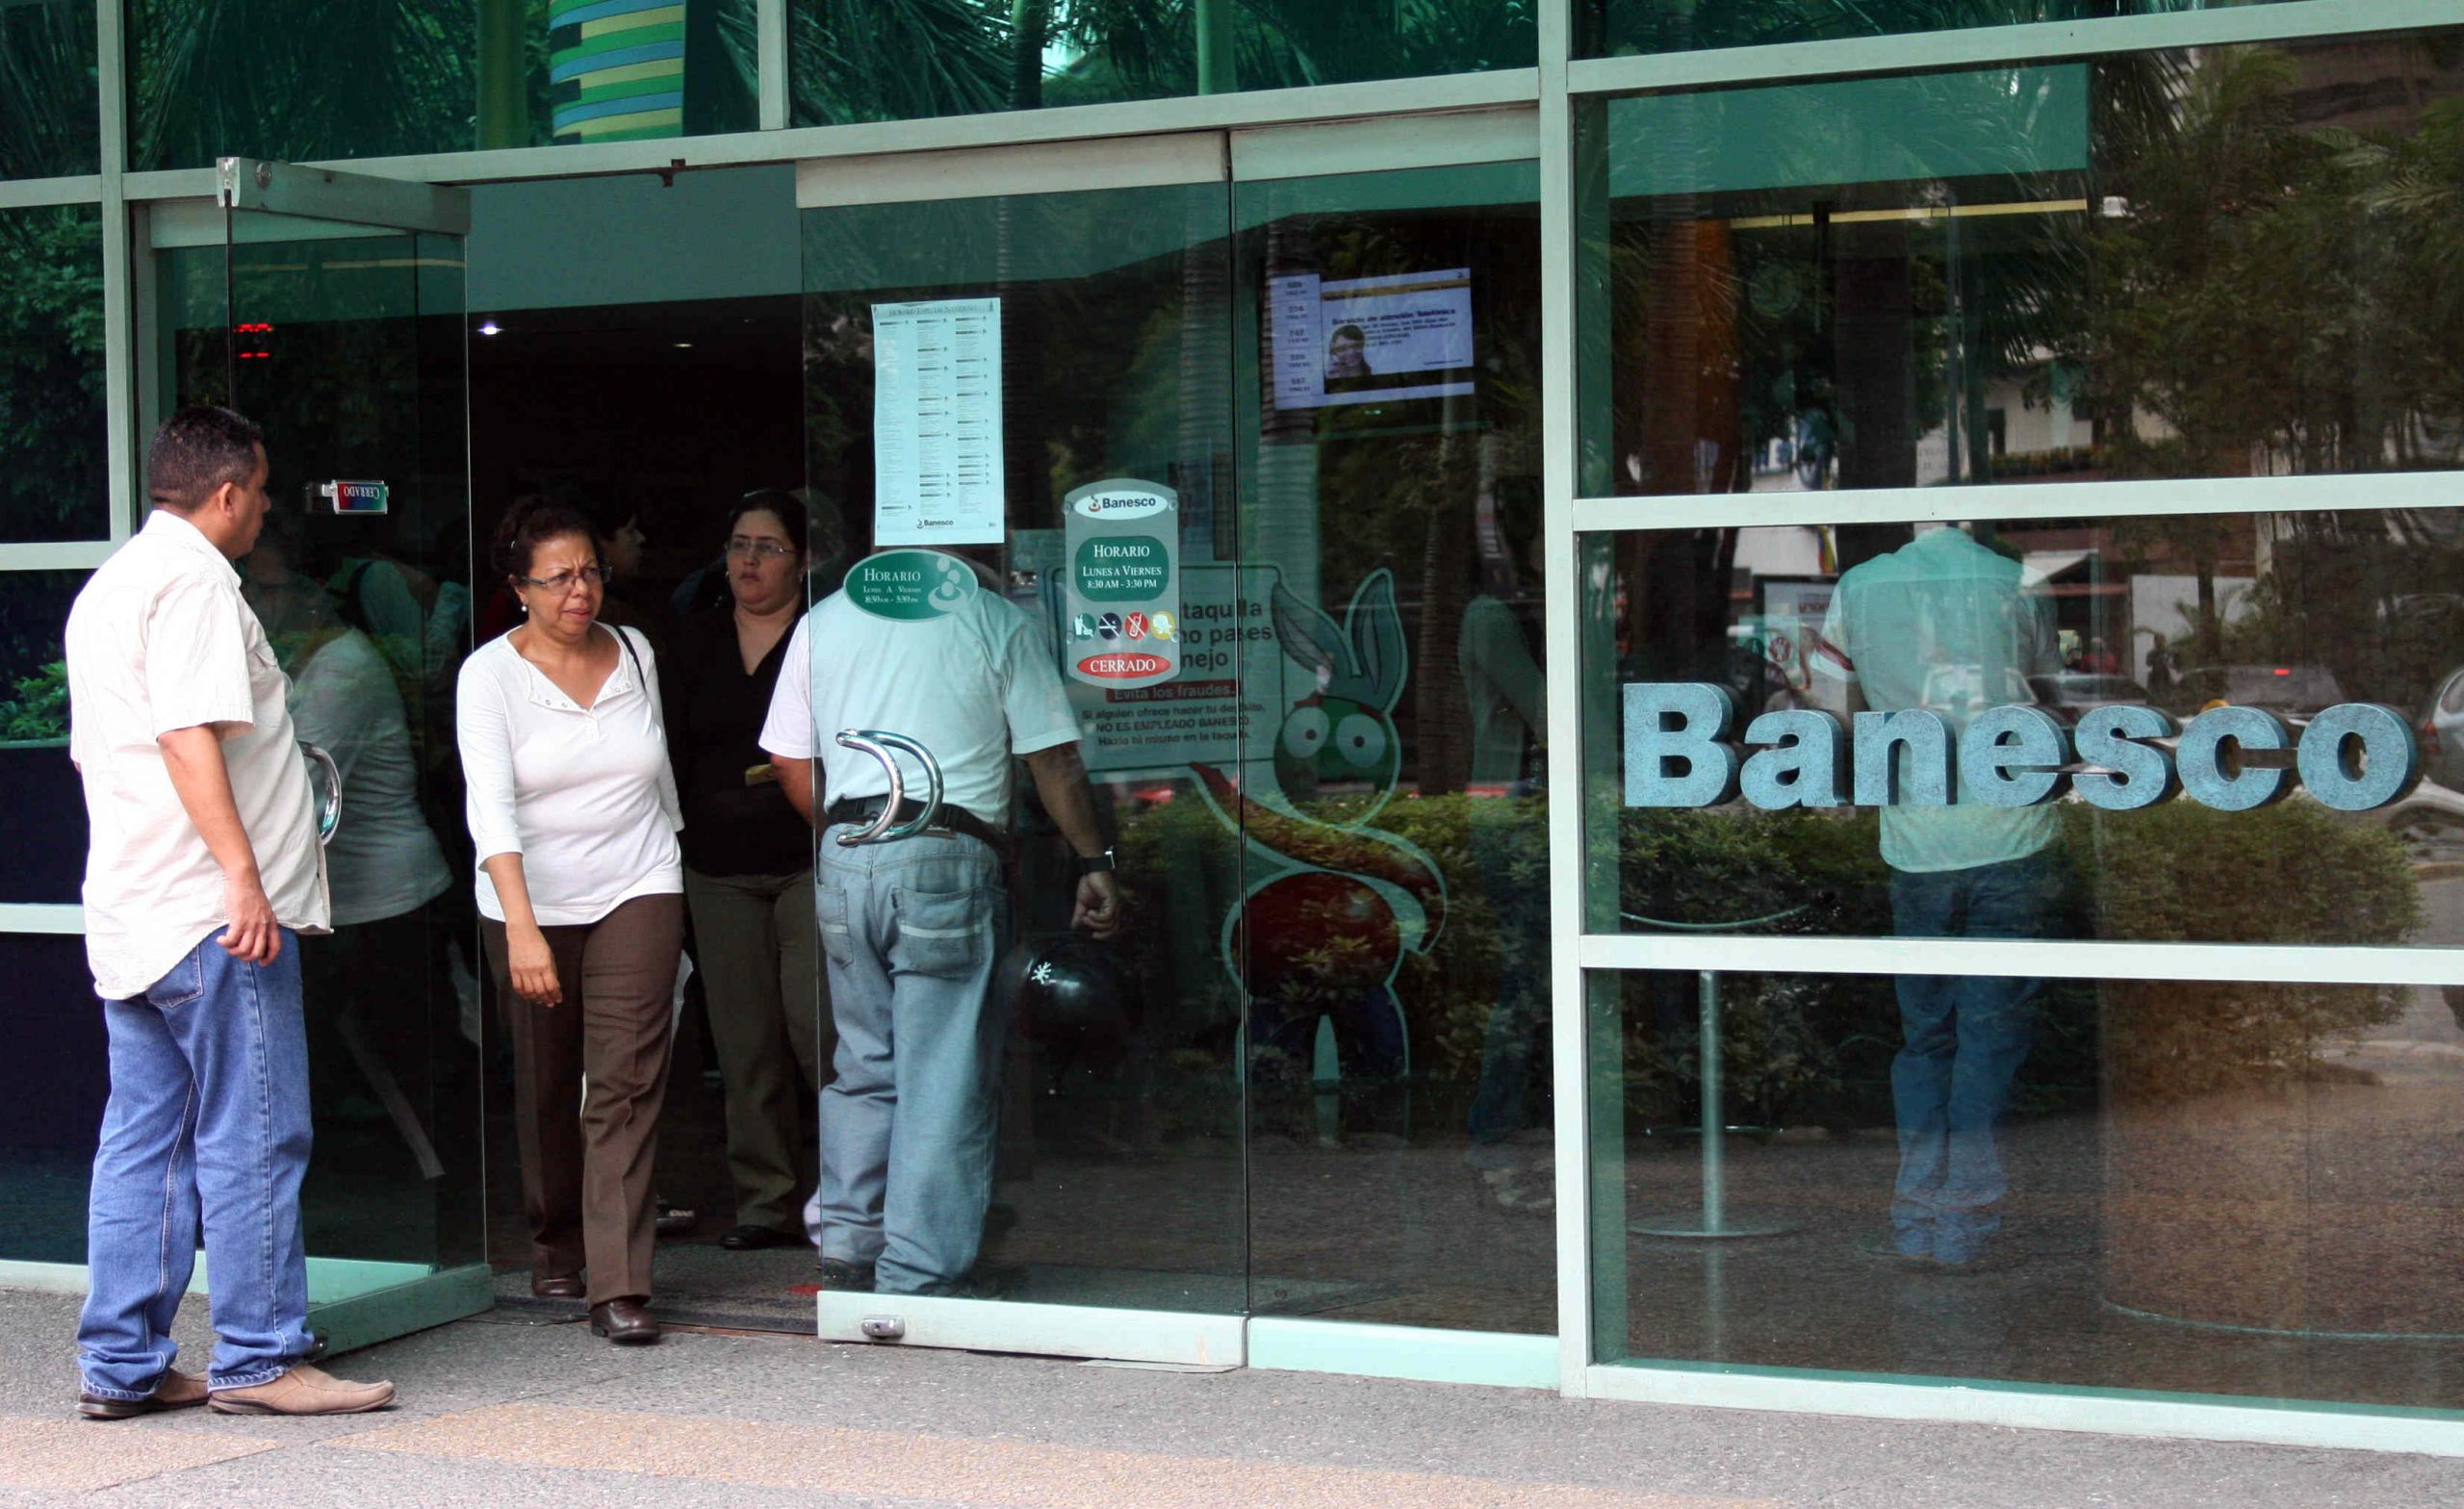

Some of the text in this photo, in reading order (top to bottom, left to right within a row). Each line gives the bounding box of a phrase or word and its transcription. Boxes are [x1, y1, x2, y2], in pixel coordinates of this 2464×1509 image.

[344, 486, 379, 499] CERRADO
[1102, 498, 1156, 509] Banesco
[1093, 545, 1150, 557] HORARIO
[864, 568, 921, 581] HORARIO
[1083, 566, 1113, 576] LUNES
[1122, 565, 1162, 576] VIERNES
[1087, 579, 1103, 588] 8:30
[1126, 579, 1142, 588] 3:30
[1143, 579, 1157, 588] PM
[1090, 658, 1156, 672] CERRADO
[1114, 687, 1149, 701] Evita
[1153, 685, 1173, 699] los
[1199, 716, 1249, 729] BANESO
[1623, 682, 2417, 811] Banesco
